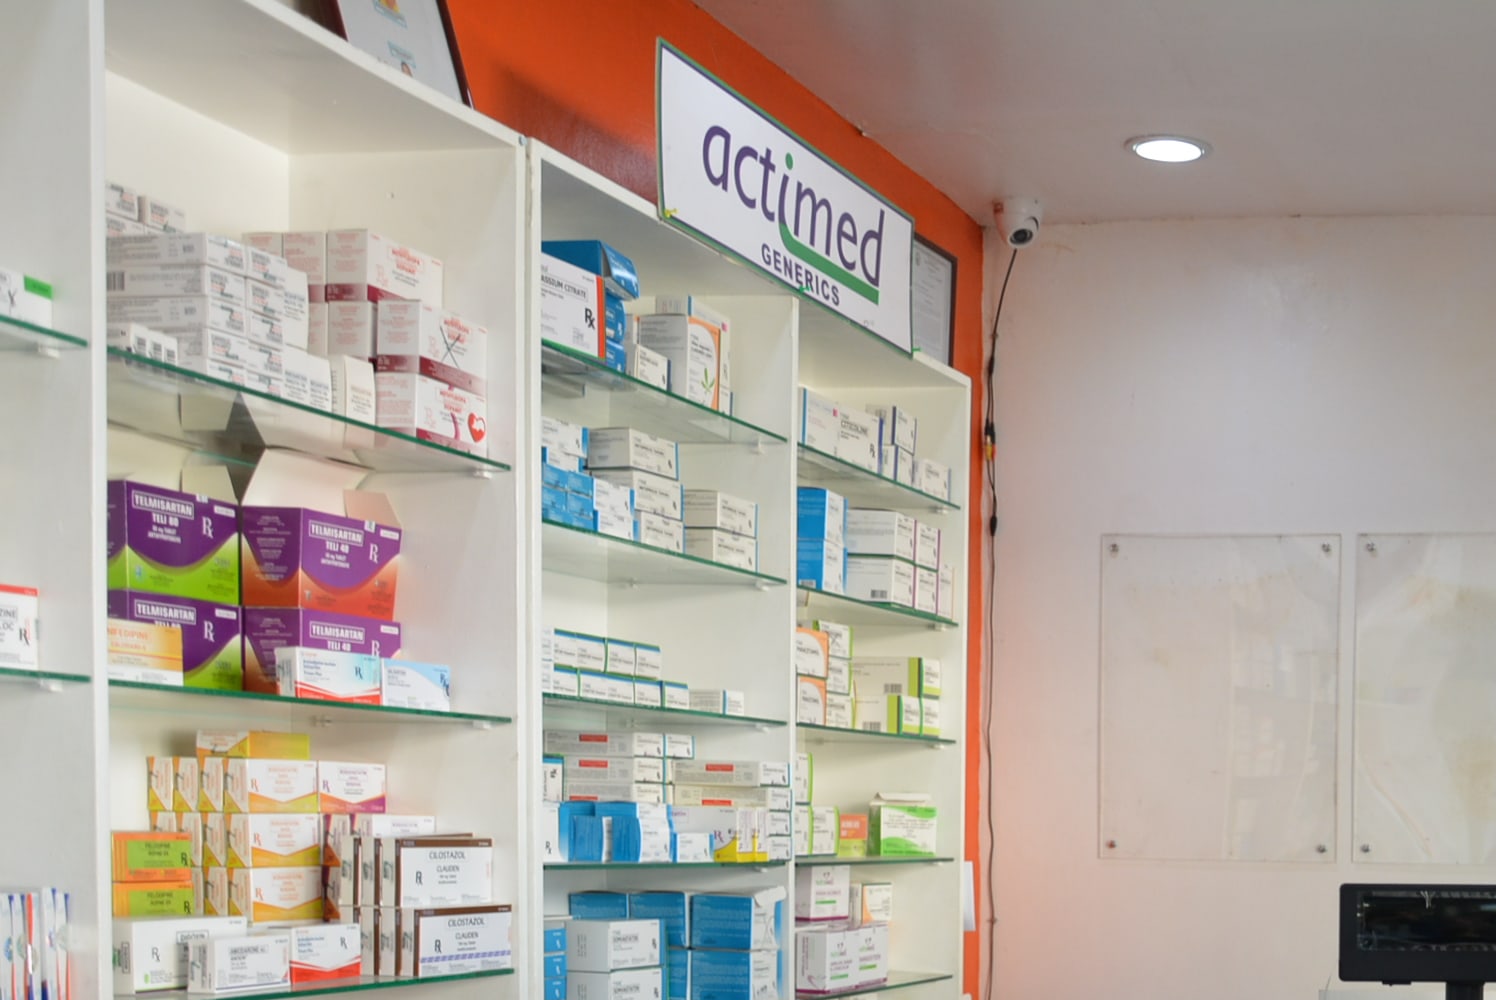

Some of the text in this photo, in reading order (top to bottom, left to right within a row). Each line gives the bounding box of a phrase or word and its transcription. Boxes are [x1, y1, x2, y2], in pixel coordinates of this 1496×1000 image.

[703, 125, 885, 287] actimed
[761, 243, 840, 306] GENERICS
[134, 494, 193, 516] TELMISARTAN
[311, 524, 363, 543] TELMISARTAN
[137, 603, 195, 621] TELMISARTAN
[312, 624, 364, 641] TELMISARTAN
[429, 850, 466, 861] CILOSTAZOL
[448, 917, 485, 929] CILOSTAZOL
